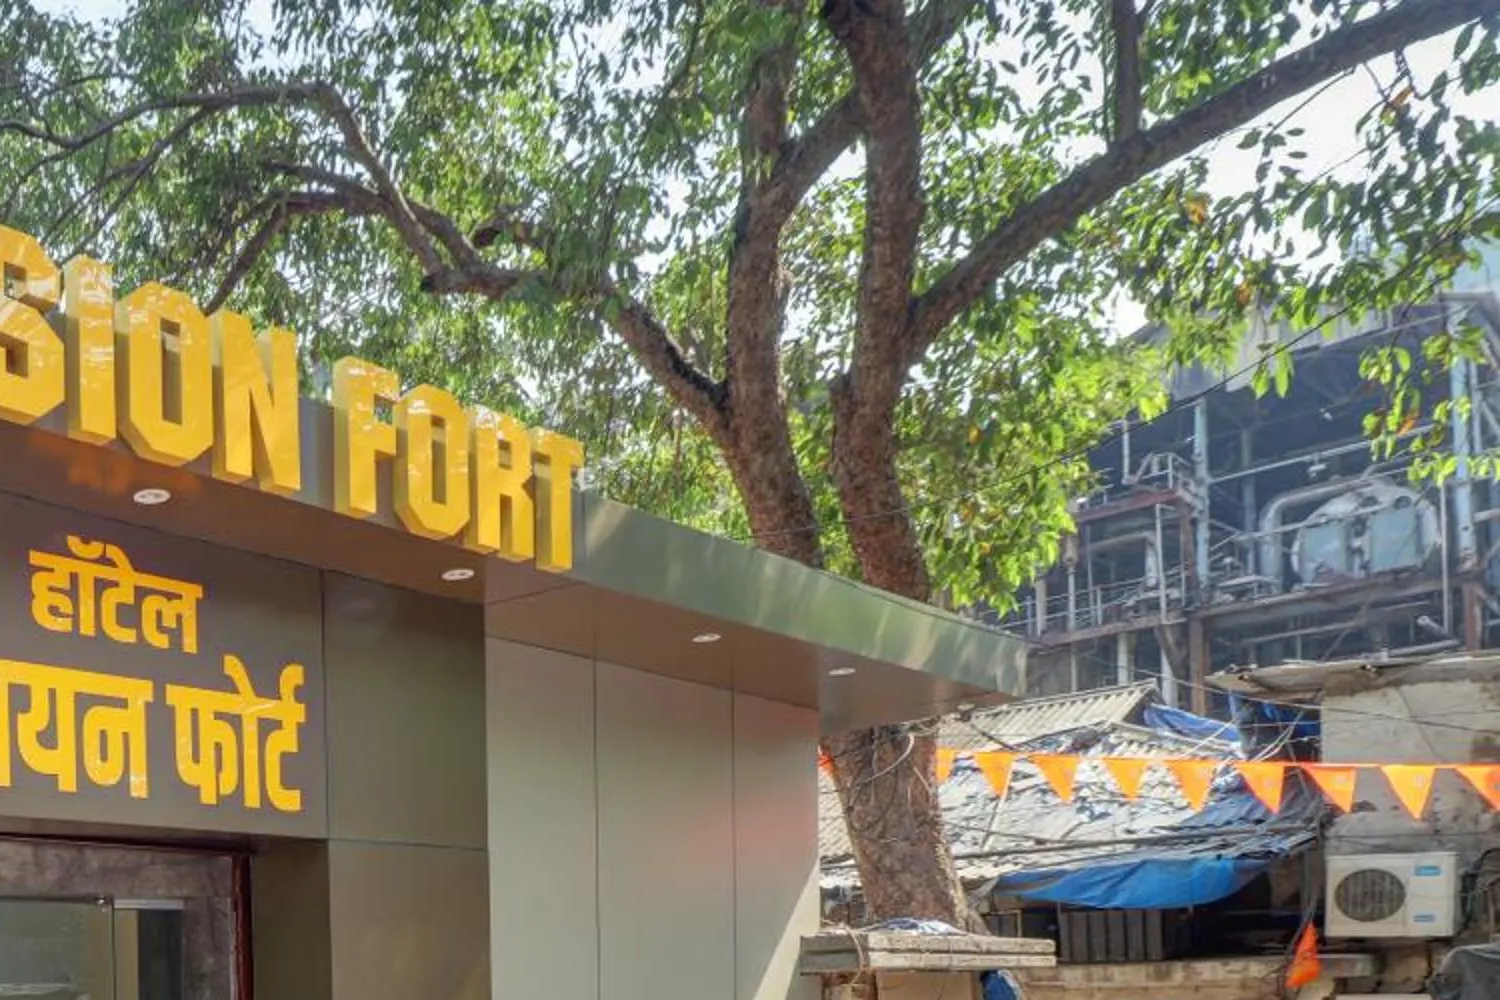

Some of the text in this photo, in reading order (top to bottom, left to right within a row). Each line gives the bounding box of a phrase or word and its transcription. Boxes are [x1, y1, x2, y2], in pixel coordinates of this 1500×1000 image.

[332, 356, 584, 572] FORT
[29, 535, 203, 654] हॉटेल
[165, 654, 306, 813] फोर्ट
